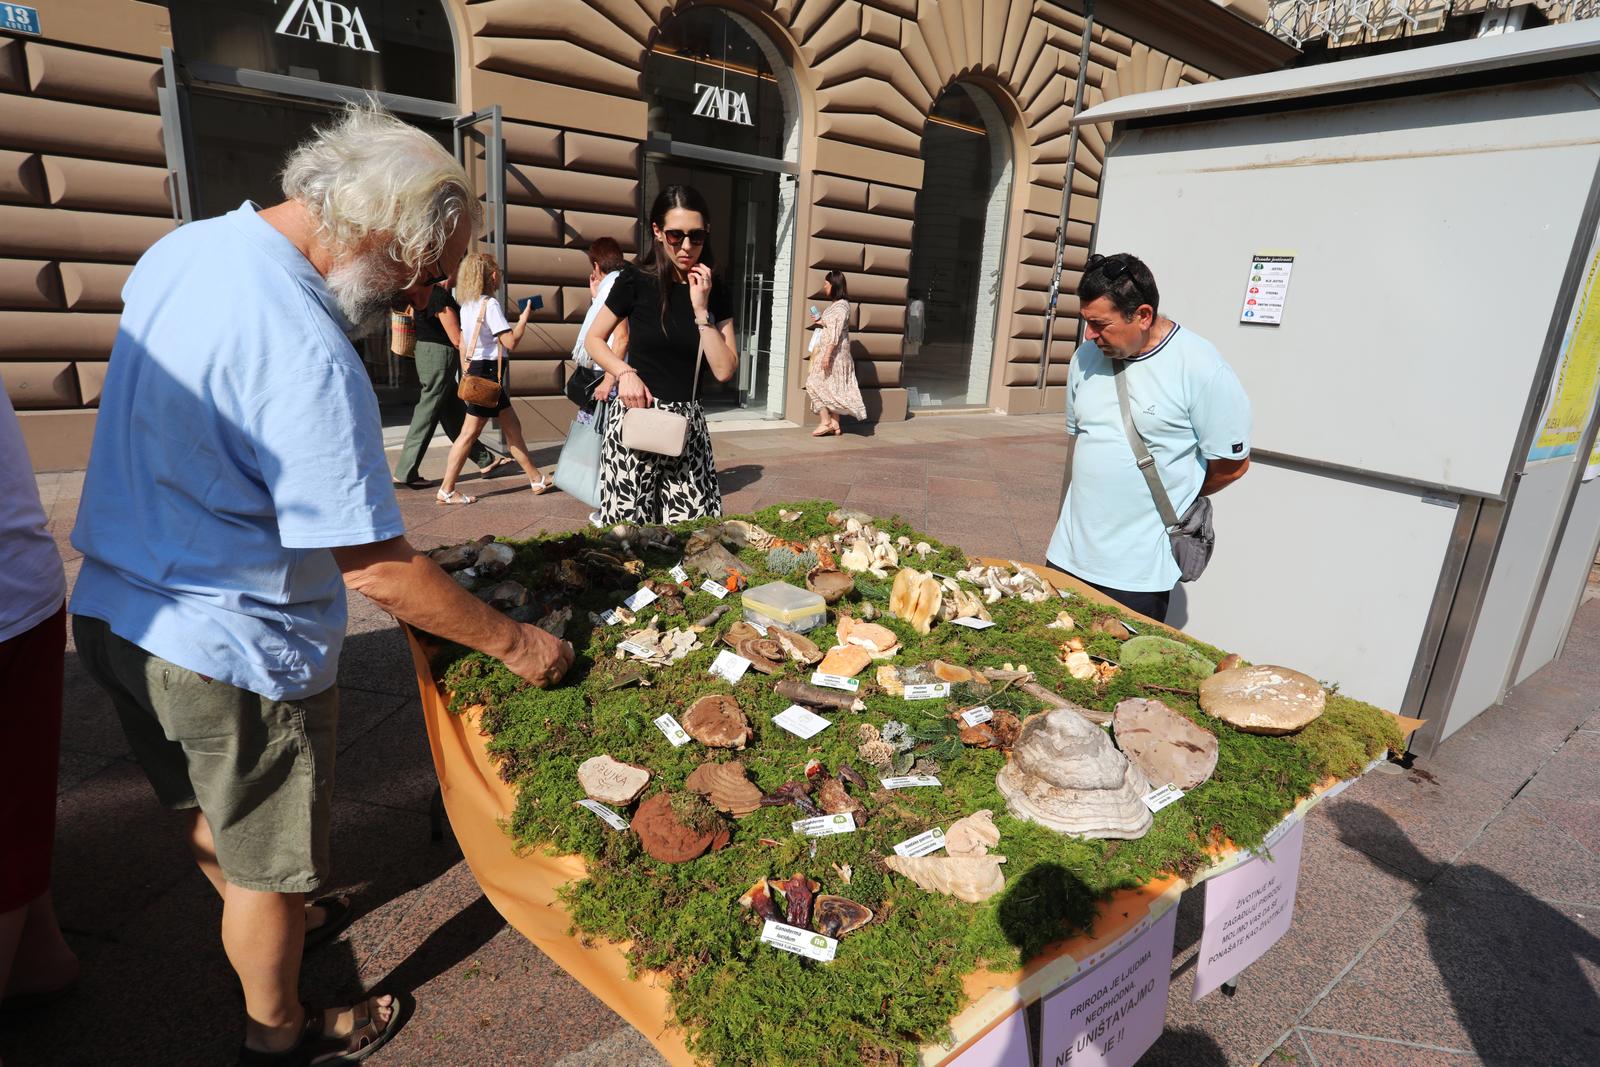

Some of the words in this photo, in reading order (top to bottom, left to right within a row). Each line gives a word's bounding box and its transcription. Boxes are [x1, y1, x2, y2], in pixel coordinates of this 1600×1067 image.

[5, 5, 30, 24] 13
[275, 0, 380, 53] ZARA
[692, 82, 755, 126] ZARA
[814, 937, 825, 947] ne
[1069, 984, 1109, 1020] PRIRODA
[1109, 974, 1121, 991] JE
[1121, 950, 1152, 981] LJUDIMA
[1056, 1045, 1074, 1067] NE
[1076, 978, 1156, 1054] UNIŠTAVAJMO
[1100, 1036, 1116, 1057] JE
